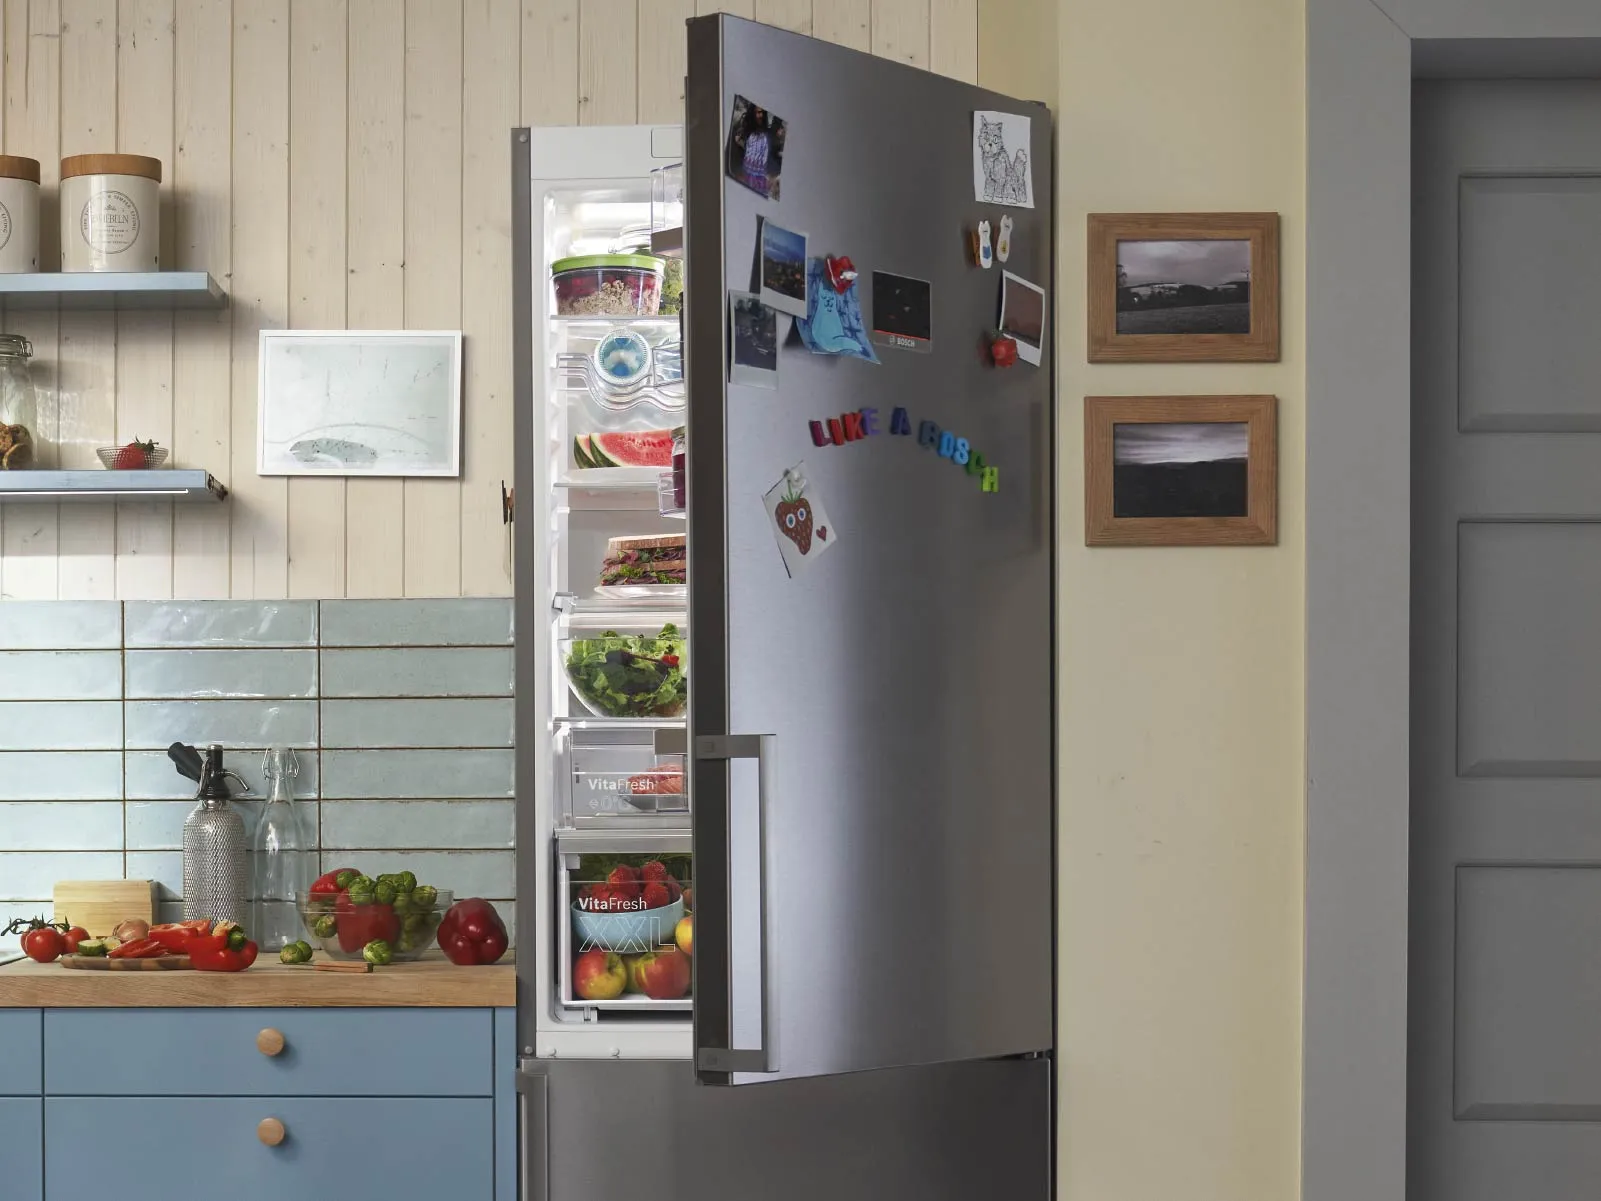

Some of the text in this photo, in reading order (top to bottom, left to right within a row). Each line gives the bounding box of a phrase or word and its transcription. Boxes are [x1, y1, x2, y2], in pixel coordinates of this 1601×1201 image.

[897, 336, 915, 348] BOSCH
[809, 406, 998, 492] LIKE A BOSCH
[587, 778, 654, 791] VitaFresh
[578, 896, 647, 910] VitaFresh
[579, 916, 676, 953] XXL
